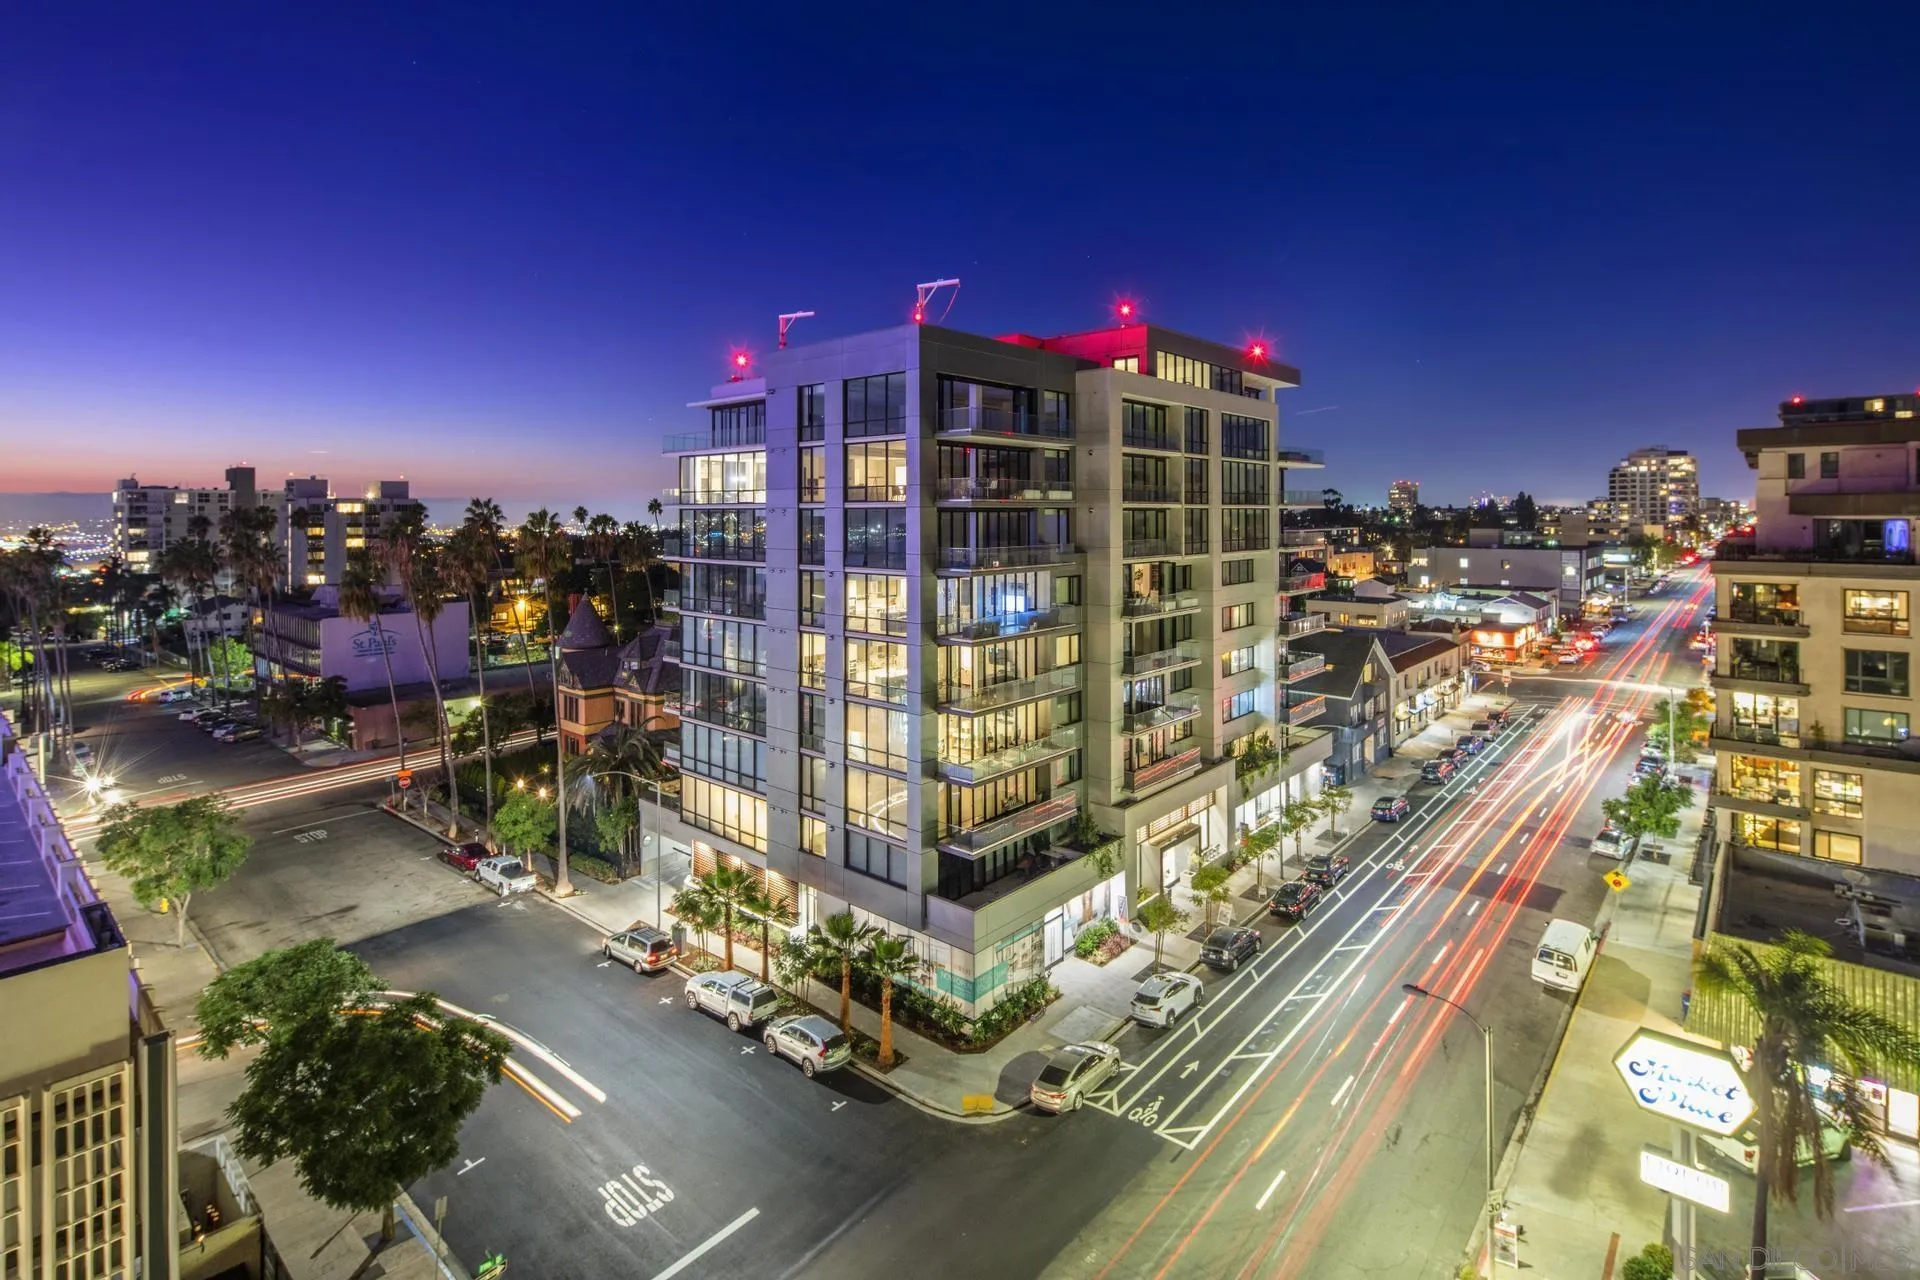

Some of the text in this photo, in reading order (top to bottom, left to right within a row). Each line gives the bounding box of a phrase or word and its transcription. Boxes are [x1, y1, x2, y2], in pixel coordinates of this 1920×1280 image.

[157, 773, 187, 784] STOP
[293, 829, 328, 844] STOP
[1628, 1058, 1740, 1100] Maket
[597, 1164, 675, 1227] STOP
[1488, 1202, 1501, 1213] 30
